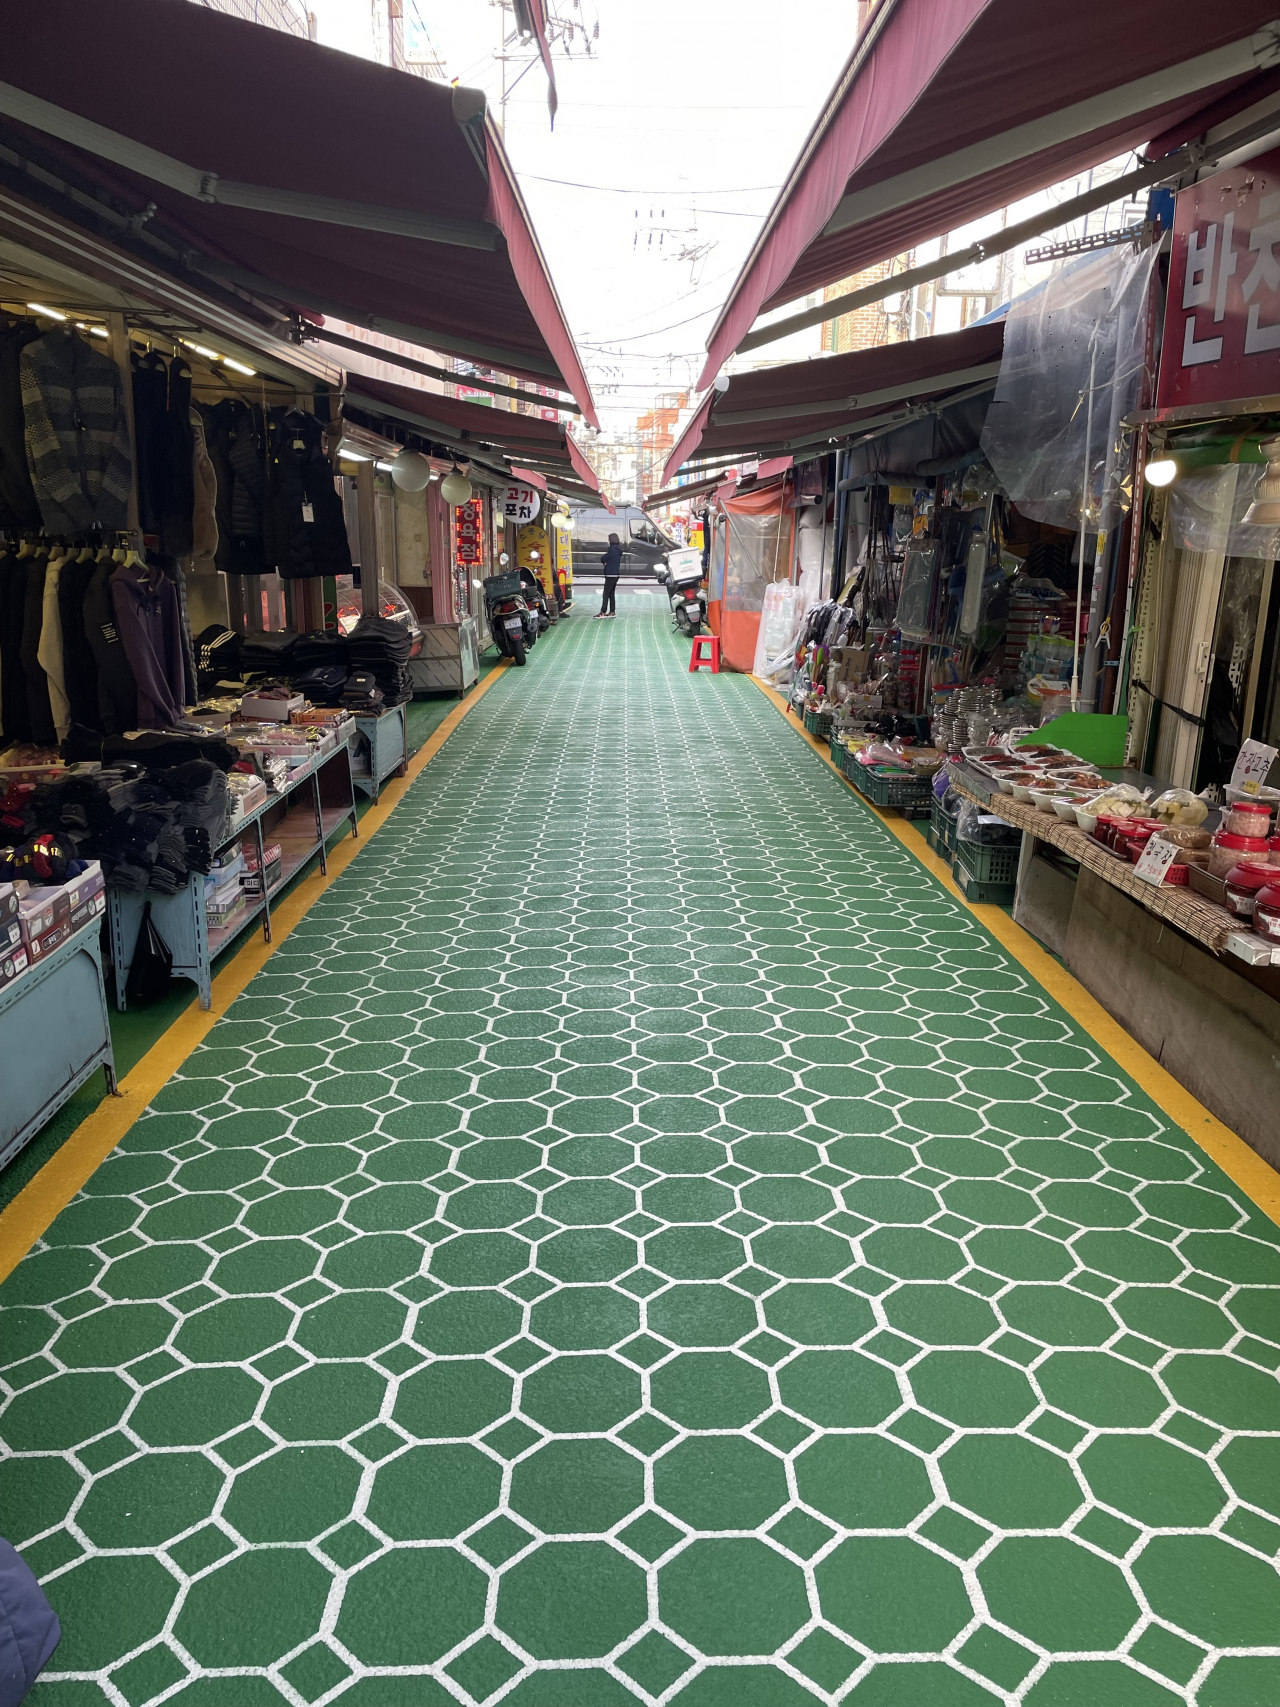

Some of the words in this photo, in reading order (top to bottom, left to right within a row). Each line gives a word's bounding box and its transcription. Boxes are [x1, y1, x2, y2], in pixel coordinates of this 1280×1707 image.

[506, 487, 533, 503] 고기
[505, 503, 532, 519] 포차
[460, 503, 476, 560] 정육점
[1146, 840, 1173, 865] 청국장
